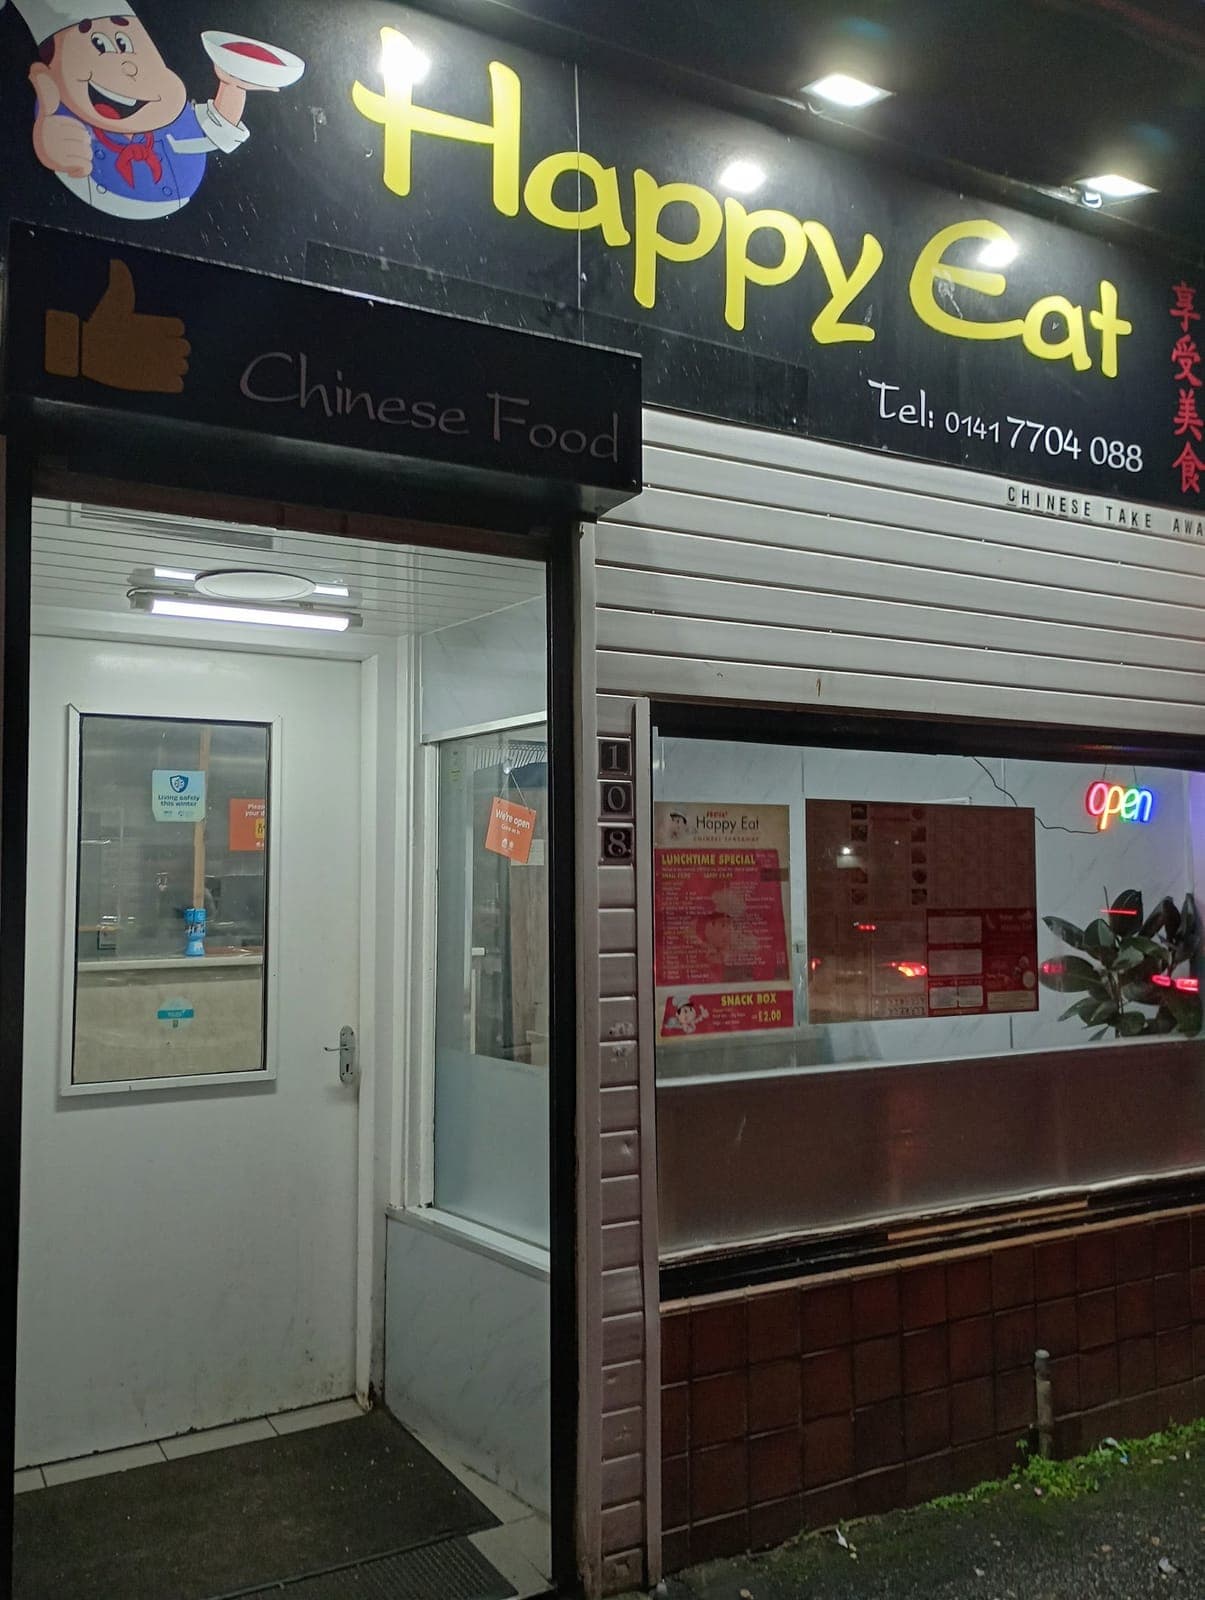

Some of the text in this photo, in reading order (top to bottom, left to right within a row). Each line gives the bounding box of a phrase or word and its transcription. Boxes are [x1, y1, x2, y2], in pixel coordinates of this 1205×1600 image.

[351, 26, 1132, 378] Happy Eat
[239, 352, 619, 463] Chinese Food
[1169, 281, 1205, 494] 享受美食
[867, 379, 1143, 473] Tel: 0141 7704 088
[1007, 486, 1091, 517] CHINESE
[1106, 506, 1152, 529] TAKE
[513, 817, 530, 829] open
[696, 815, 760, 834] Happy Eat
[661, 854, 716, 866] LUNCHTIME
[719, 854, 756, 865] SPECIAL
[721, 992, 777, 1007] SNACK BOX
